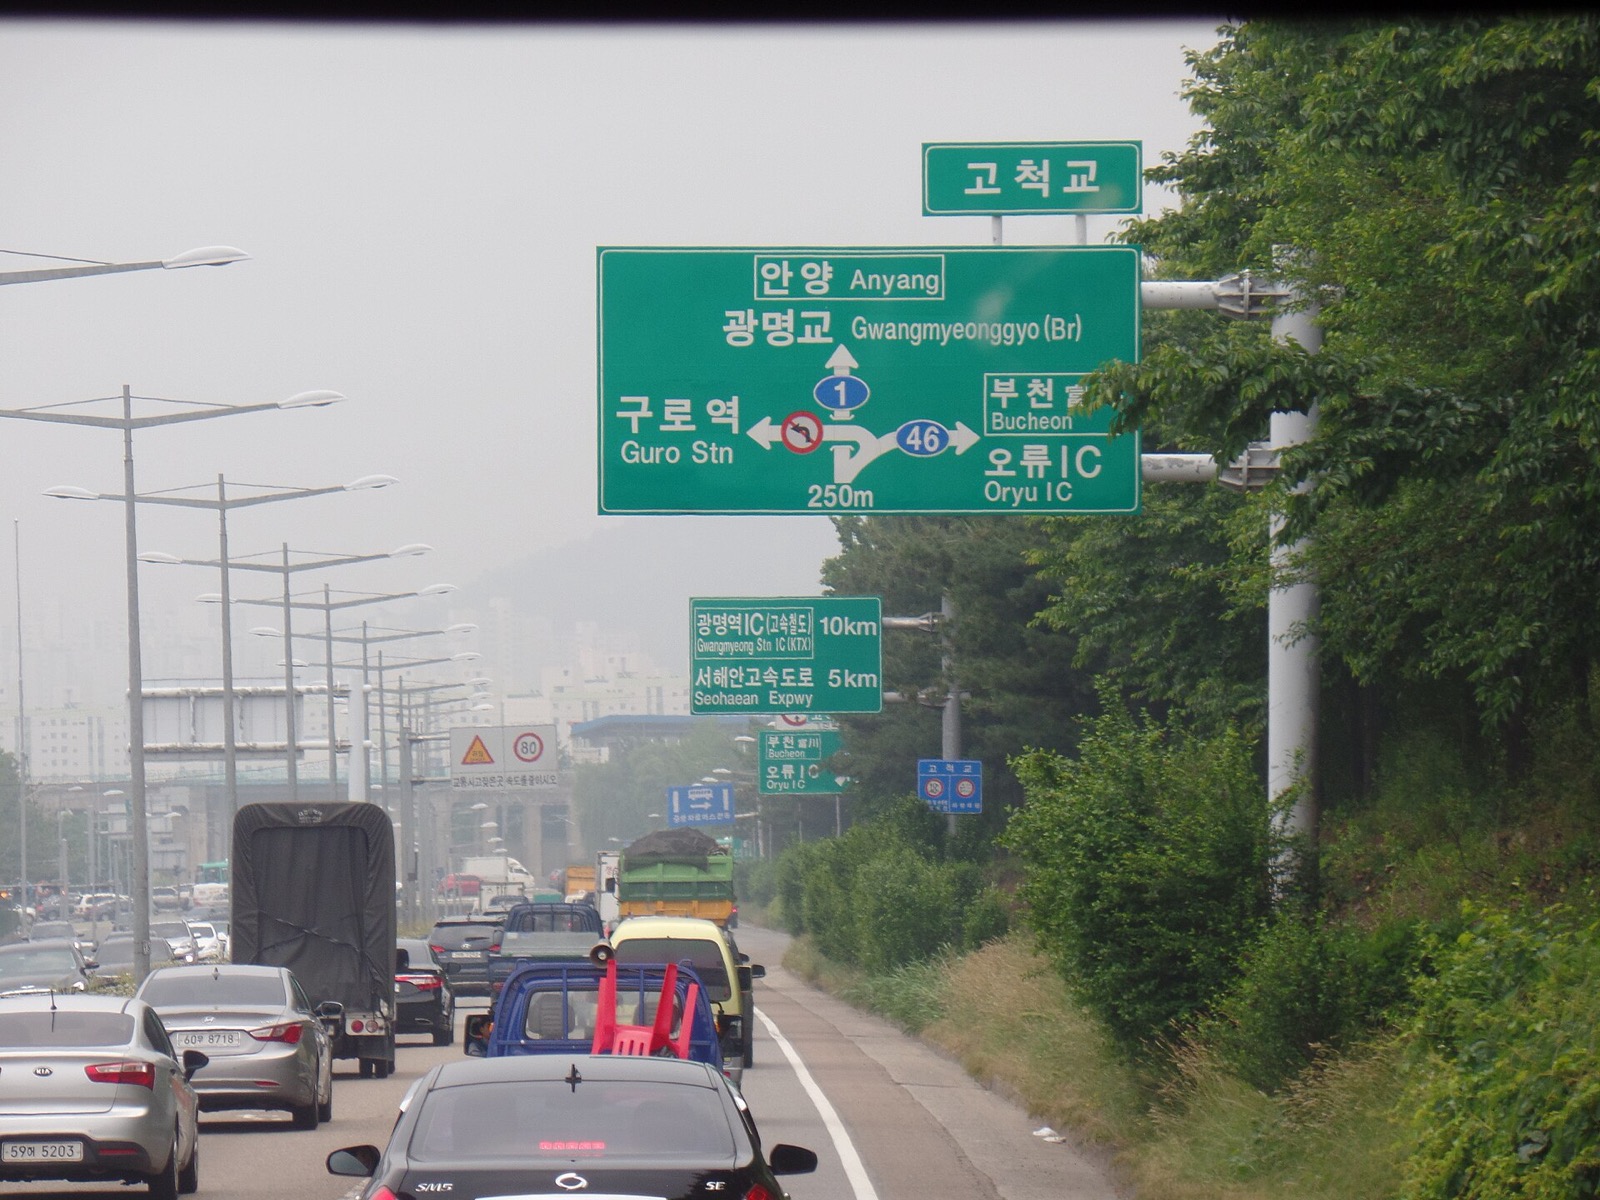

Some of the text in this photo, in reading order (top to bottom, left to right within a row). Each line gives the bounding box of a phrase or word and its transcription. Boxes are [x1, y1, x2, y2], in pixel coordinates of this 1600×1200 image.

[964, 159, 1101, 198] 고척교
[759, 260, 940, 296] 안양 Anyang
[722, 309, 834, 347] 광명교
[834, 380, 847, 406] 1
[990, 378, 1054, 409] 부천
[616, 395, 739, 435] 구로역
[991, 411, 1073, 431] Bucheon
[906, 425, 938, 451] 46
[620, 440, 734, 464] Guro Stn
[807, 484, 874, 508] 250m
[984, 480, 1073, 507] Oryu IC
[819, 616, 877, 636] 10km
[697, 639, 754, 656] Gwangmyeong
[756, 638, 772, 652] Stn
[695, 665, 814, 689] 서해안고속도로
[694, 690, 814, 708] Seohaean Expwy
[520, 741, 537, 755] 80
[767, 736, 795, 749] 부천
[768, 749, 806, 759] Bucheon
[766, 779, 790, 791] Oryu
[208, 1034, 234, 1044] 8718
[41, 1145, 75, 1158] 5203
[415, 1182, 454, 1192] SM5
[705, 1181, 726, 1191] SE
